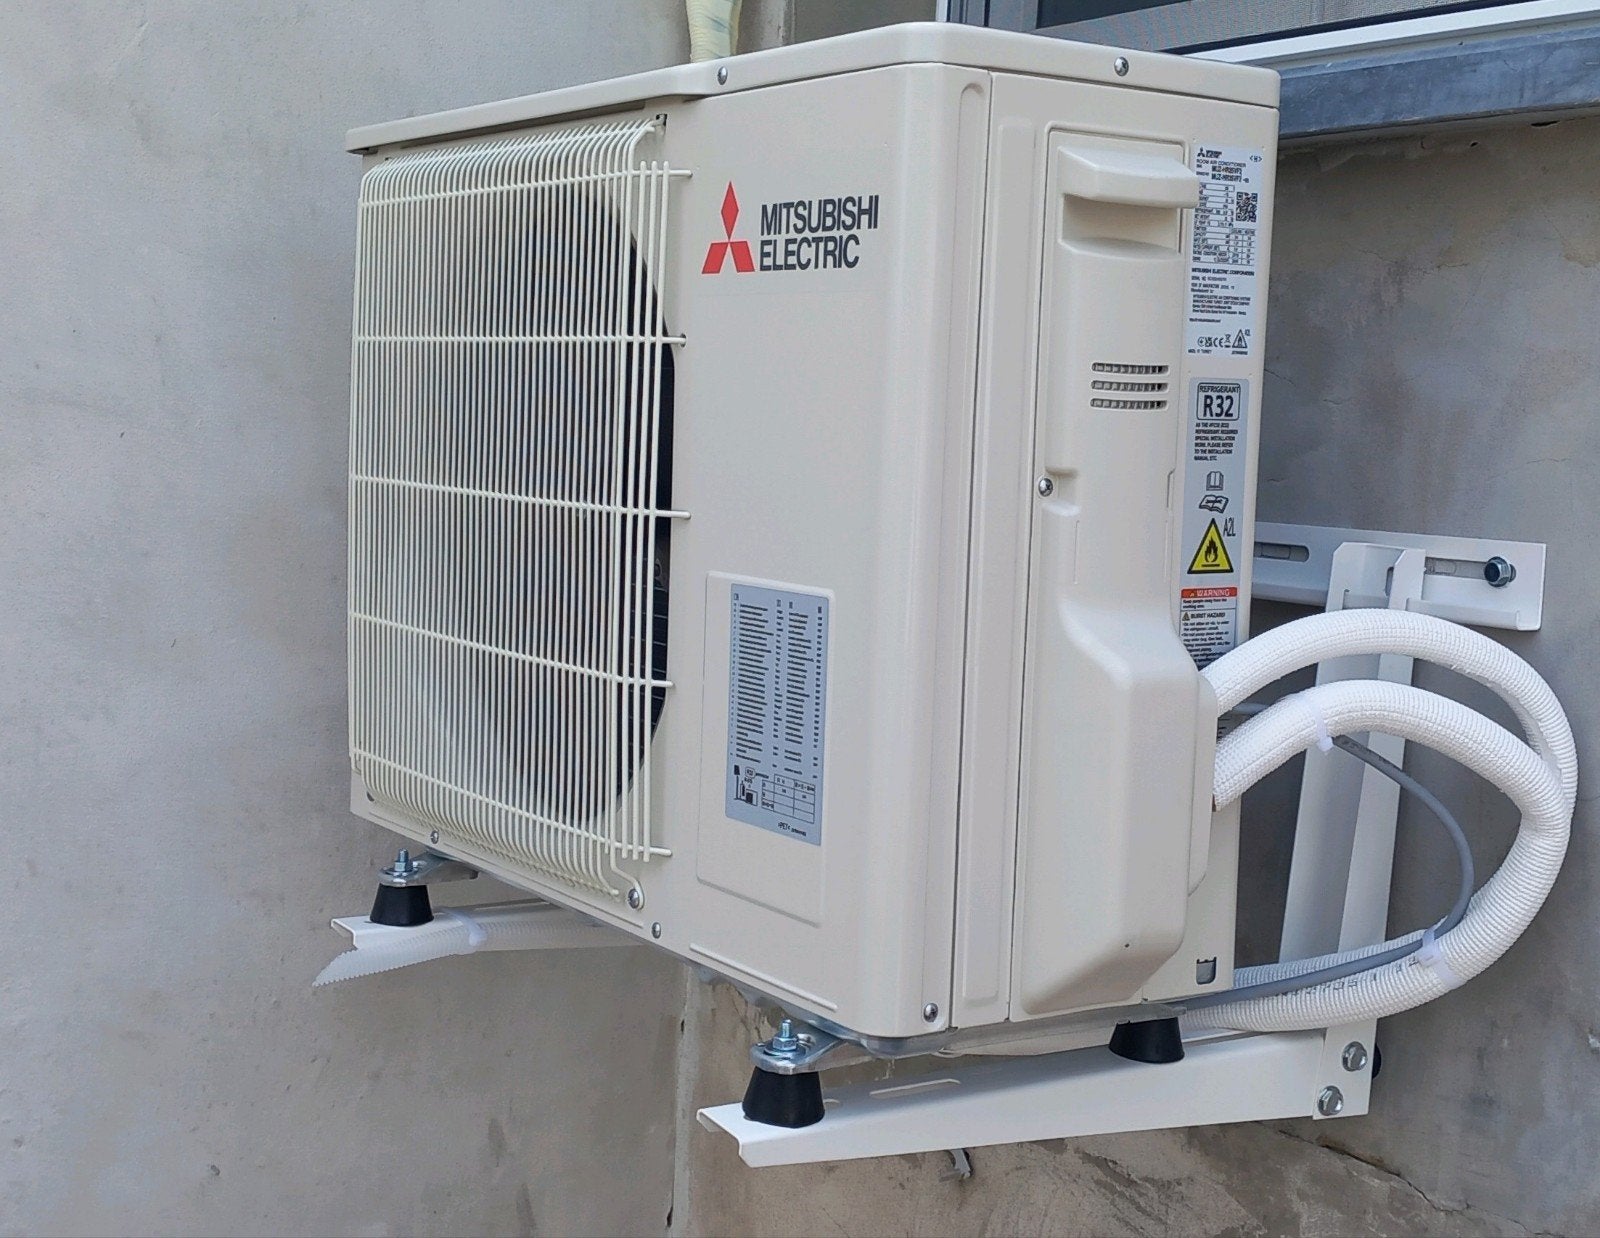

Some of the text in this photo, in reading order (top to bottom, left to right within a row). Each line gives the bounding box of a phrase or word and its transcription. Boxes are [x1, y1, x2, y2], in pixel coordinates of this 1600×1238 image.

[760, 195, 879, 236] MITSUBISHI
[760, 234, 860, 271] ELECTRIC
[1199, 385, 1240, 393] REFRIGERANT
[1203, 394, 1234, 417] R32
[1223, 517, 1236, 537] A2L
[1196, 588, 1230, 597] WARNING
